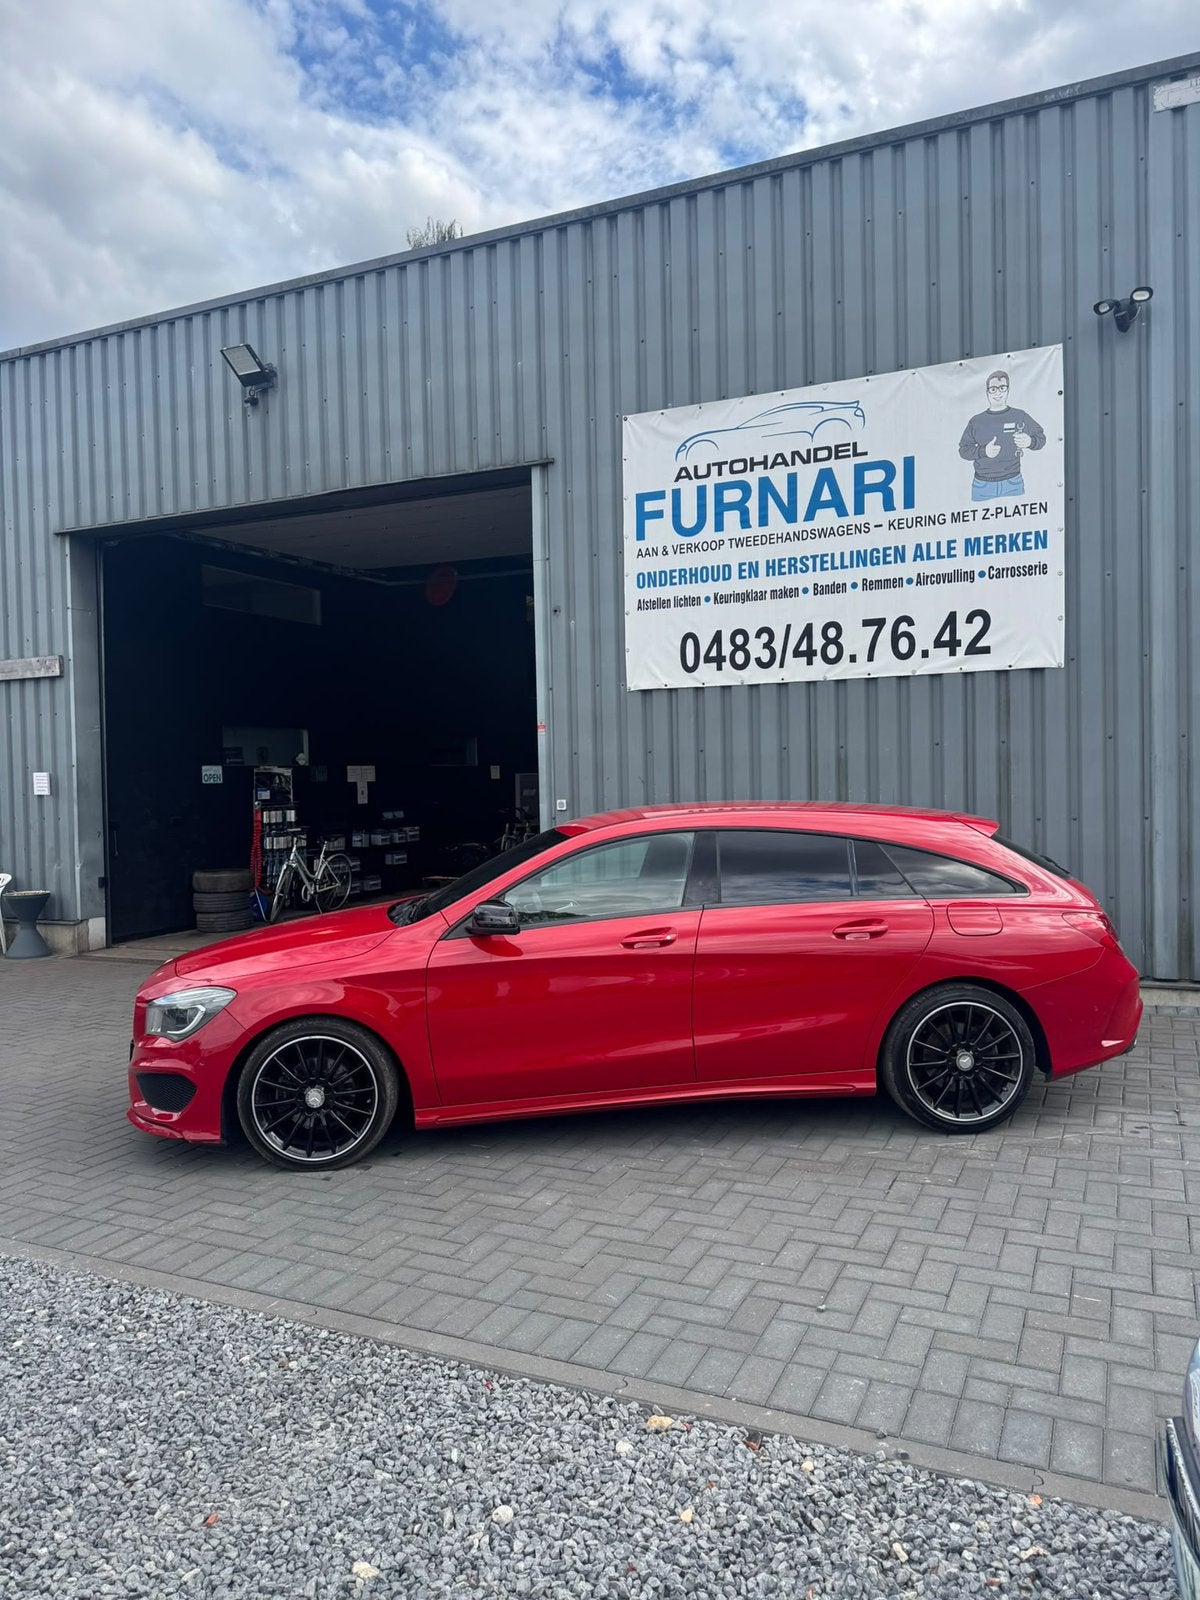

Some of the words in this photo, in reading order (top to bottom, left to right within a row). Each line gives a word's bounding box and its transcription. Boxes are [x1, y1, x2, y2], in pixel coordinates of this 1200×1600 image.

[674, 441, 868, 482] AUTOHANDEL
[635, 455, 915, 541] FURNARI
[636, 546, 659, 559] AAN
[662, 545, 669, 556] &
[672, 539, 725, 555] VERKOOP
[728, 522, 871, 549] TWEEDEHANDSWAGENS
[888, 513, 946, 531] KEURING
[950, 509, 978, 524] MET
[982, 501, 1048, 520] Z-PLATEN
[636, 563, 732, 589] ONDERHOUD
[738, 560, 759, 580] EN
[765, 544, 906, 577] HERSTELLINGEN
[912, 539, 957, 562] ALLE
[964, 530, 1048, 557] MERKEN
[637, 597, 671, 611] Afstellen
[673, 594, 701, 608] lichten
[713, 588, 767, 605] Keuringklaar
[770, 586, 799, 601] maken
[813, 581, 847, 596] Banden
[861, 576, 904, 592] Remmen
[915, 569, 975, 587] Aircovulling
[988, 561, 1048, 580] Carrosserie
[679, 608, 992, 674] 0483/48.76.42
[203, 773, 222, 782] OPEN
